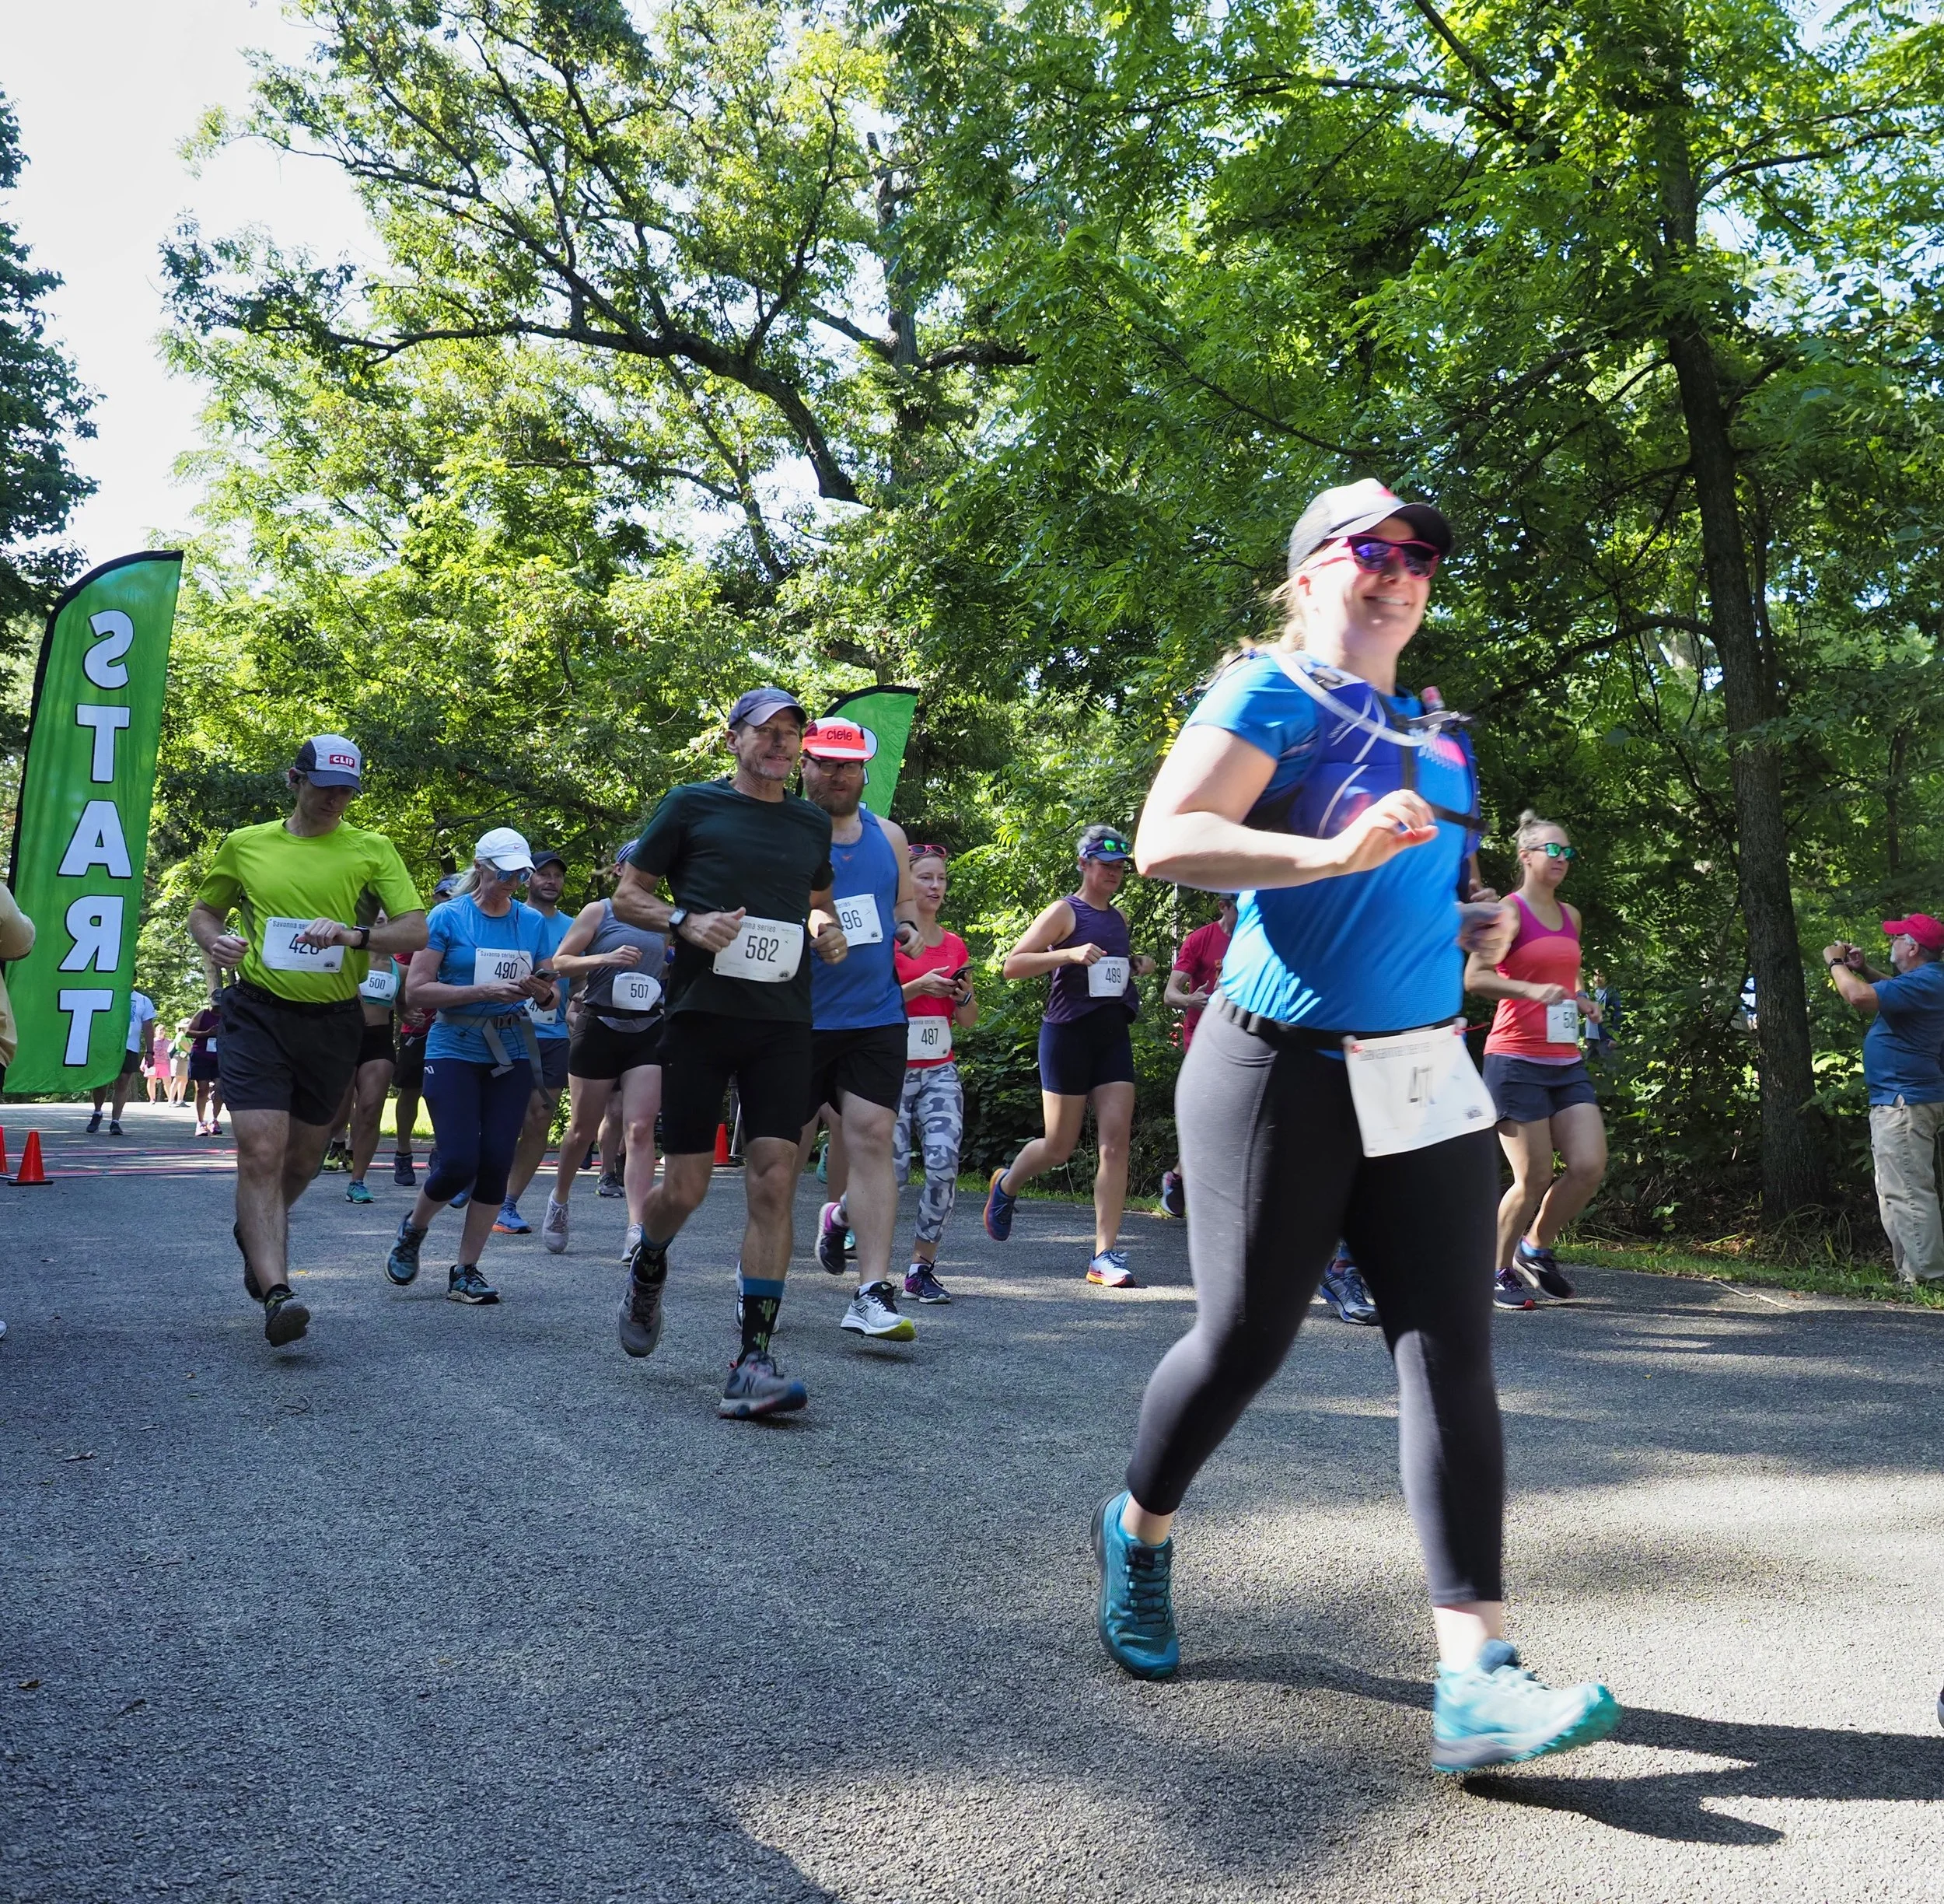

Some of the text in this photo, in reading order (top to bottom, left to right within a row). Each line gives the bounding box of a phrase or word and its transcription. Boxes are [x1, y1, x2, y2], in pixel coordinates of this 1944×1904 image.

[827, 729, 853, 741] ciele
[332, 755, 354, 766] CLIF
[841, 909, 862, 930] 96
[757, 923, 777, 933] series
[745, 934, 779, 963] 582
[495, 961, 518, 979] 490
[1105, 968, 1121, 983] 489
[369, 977, 386, 990] 500
[631, 983, 649, 999] 507
[921, 1028, 939, 1045] 487
